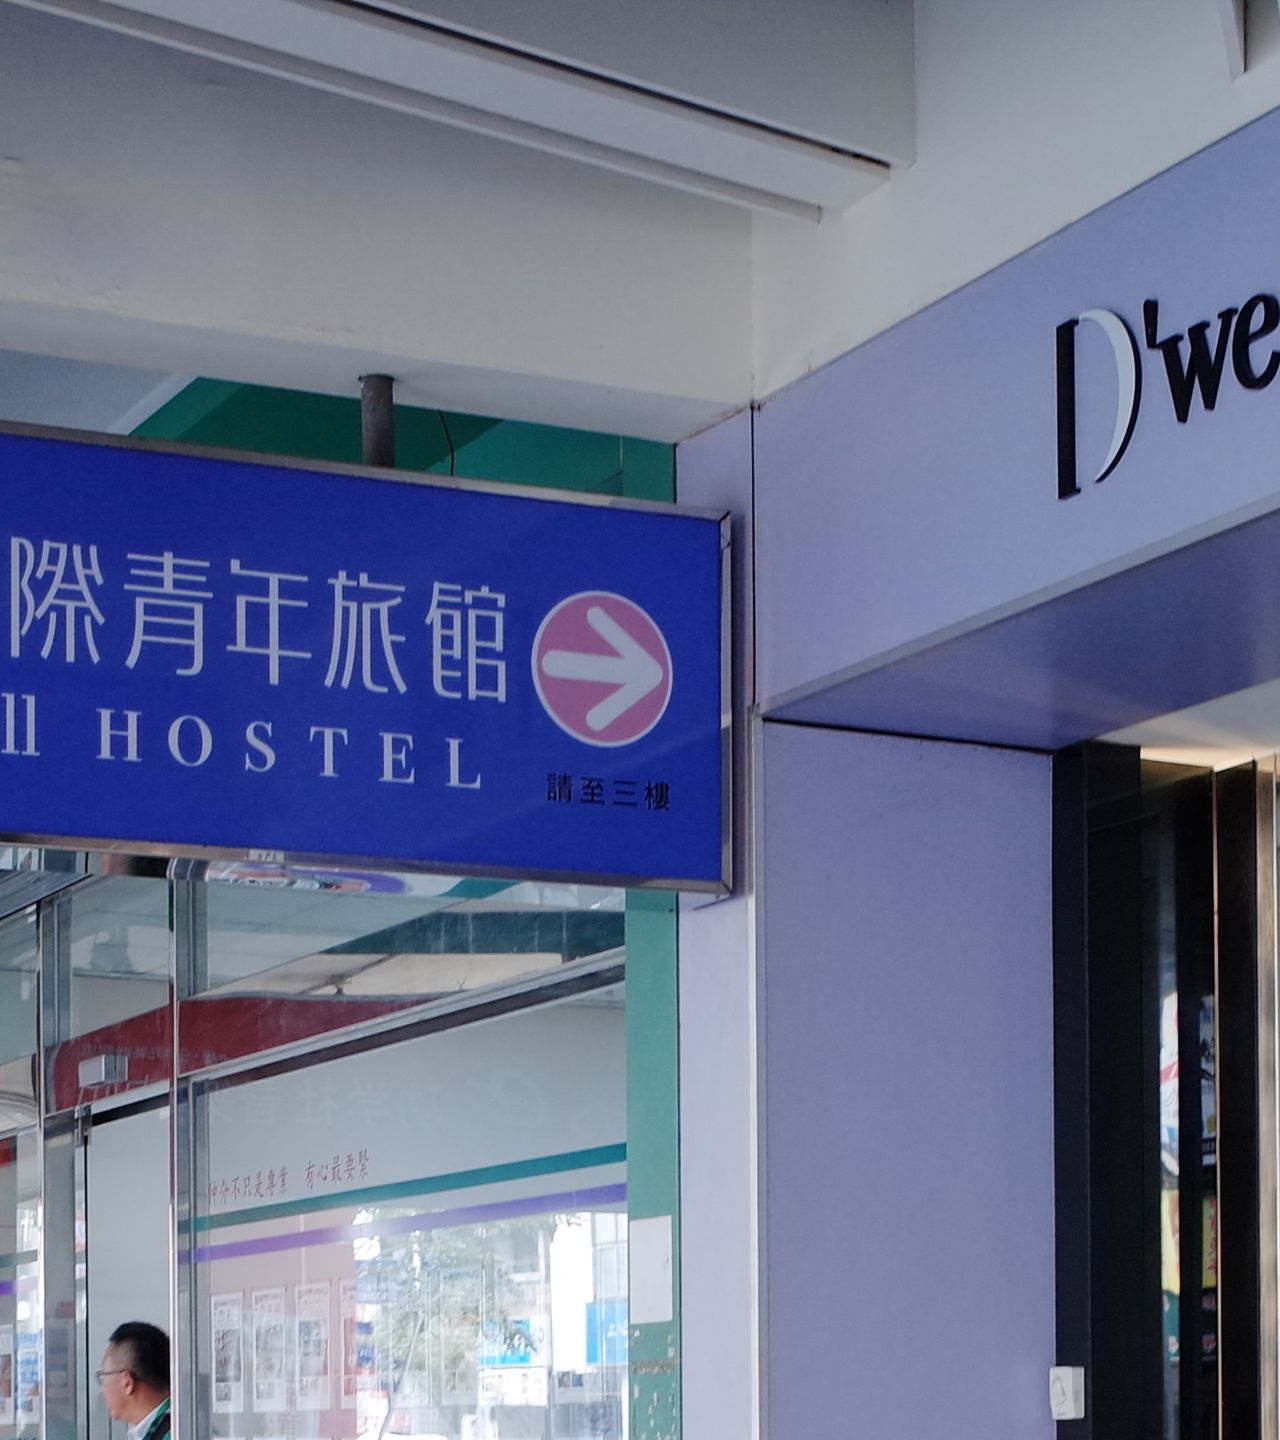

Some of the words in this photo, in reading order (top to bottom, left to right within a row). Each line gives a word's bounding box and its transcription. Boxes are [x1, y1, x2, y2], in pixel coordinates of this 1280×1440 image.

[96, 706, 484, 791] HOSTEL
[546, 772, 670, 811] 請至三樓
